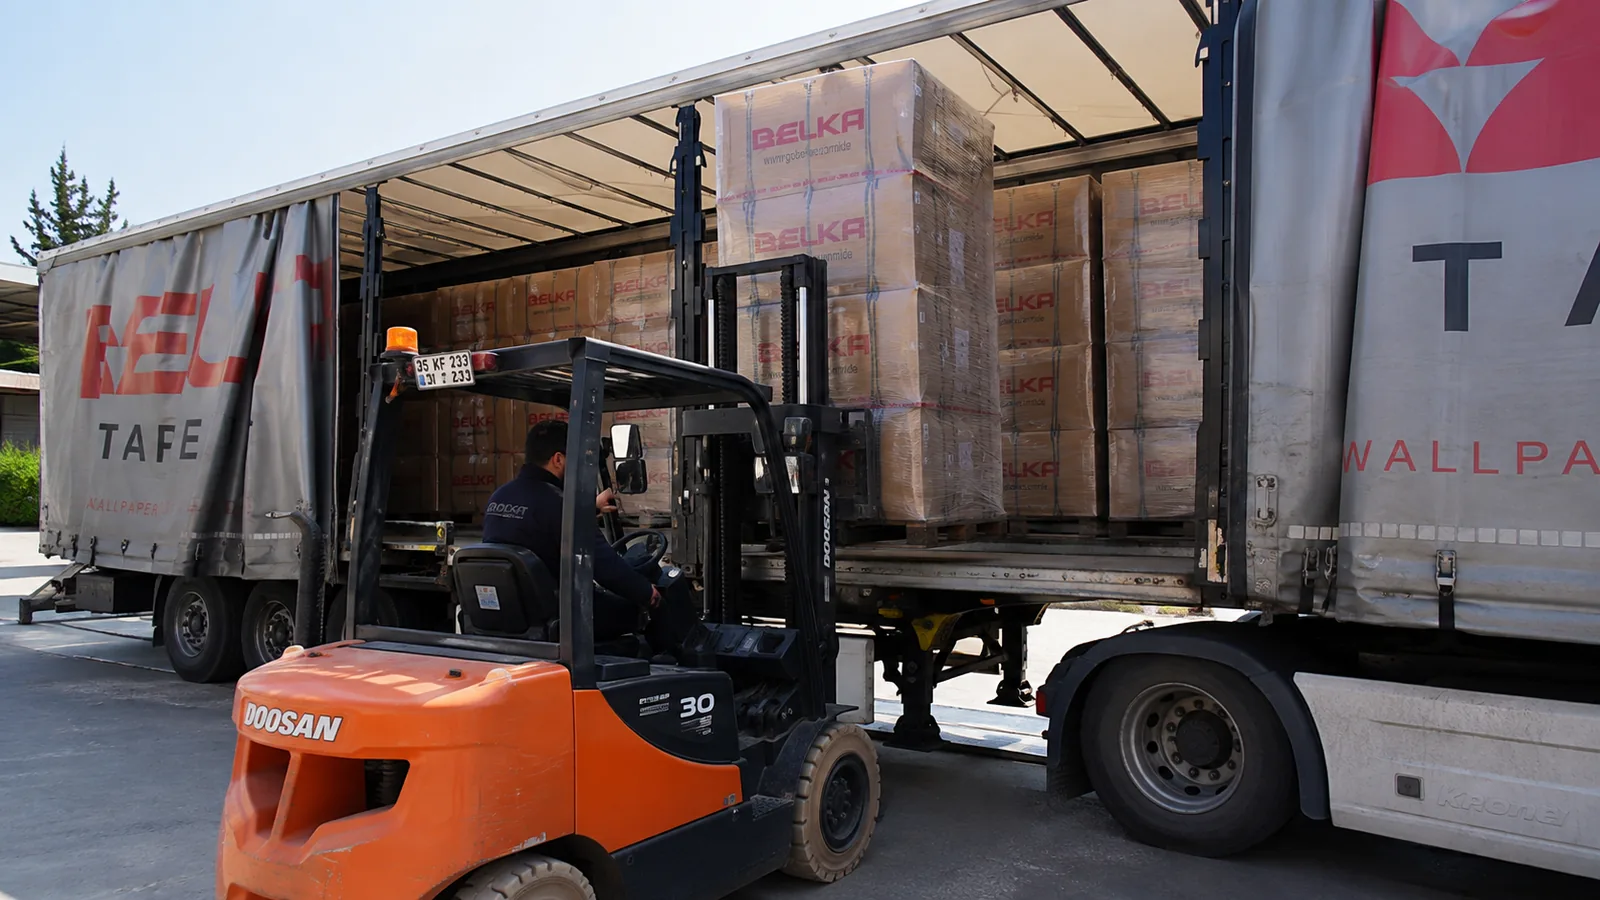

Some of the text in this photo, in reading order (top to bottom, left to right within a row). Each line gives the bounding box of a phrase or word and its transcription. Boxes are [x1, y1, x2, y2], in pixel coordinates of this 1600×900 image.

[752, 108, 865, 151] BELKA
[1139, 191, 1203, 215] BEL
[994, 210, 1054, 233] ELKA
[754, 217, 866, 253] BELKA
[614, 275, 667, 294] BELKA
[527, 290, 576, 307] BELKA
[996, 292, 1055, 314] ELKA
[758, 333, 870, 363] BKA
[416, 354, 468, 372] 35 KF 233
[1000, 376, 1055, 394] LKA
[1003, 461, 1059, 478] LKA
[823, 489, 831, 568] DOOSAN
[680, 693, 715, 718] 30
[243, 702, 343, 742] DOOSAN
